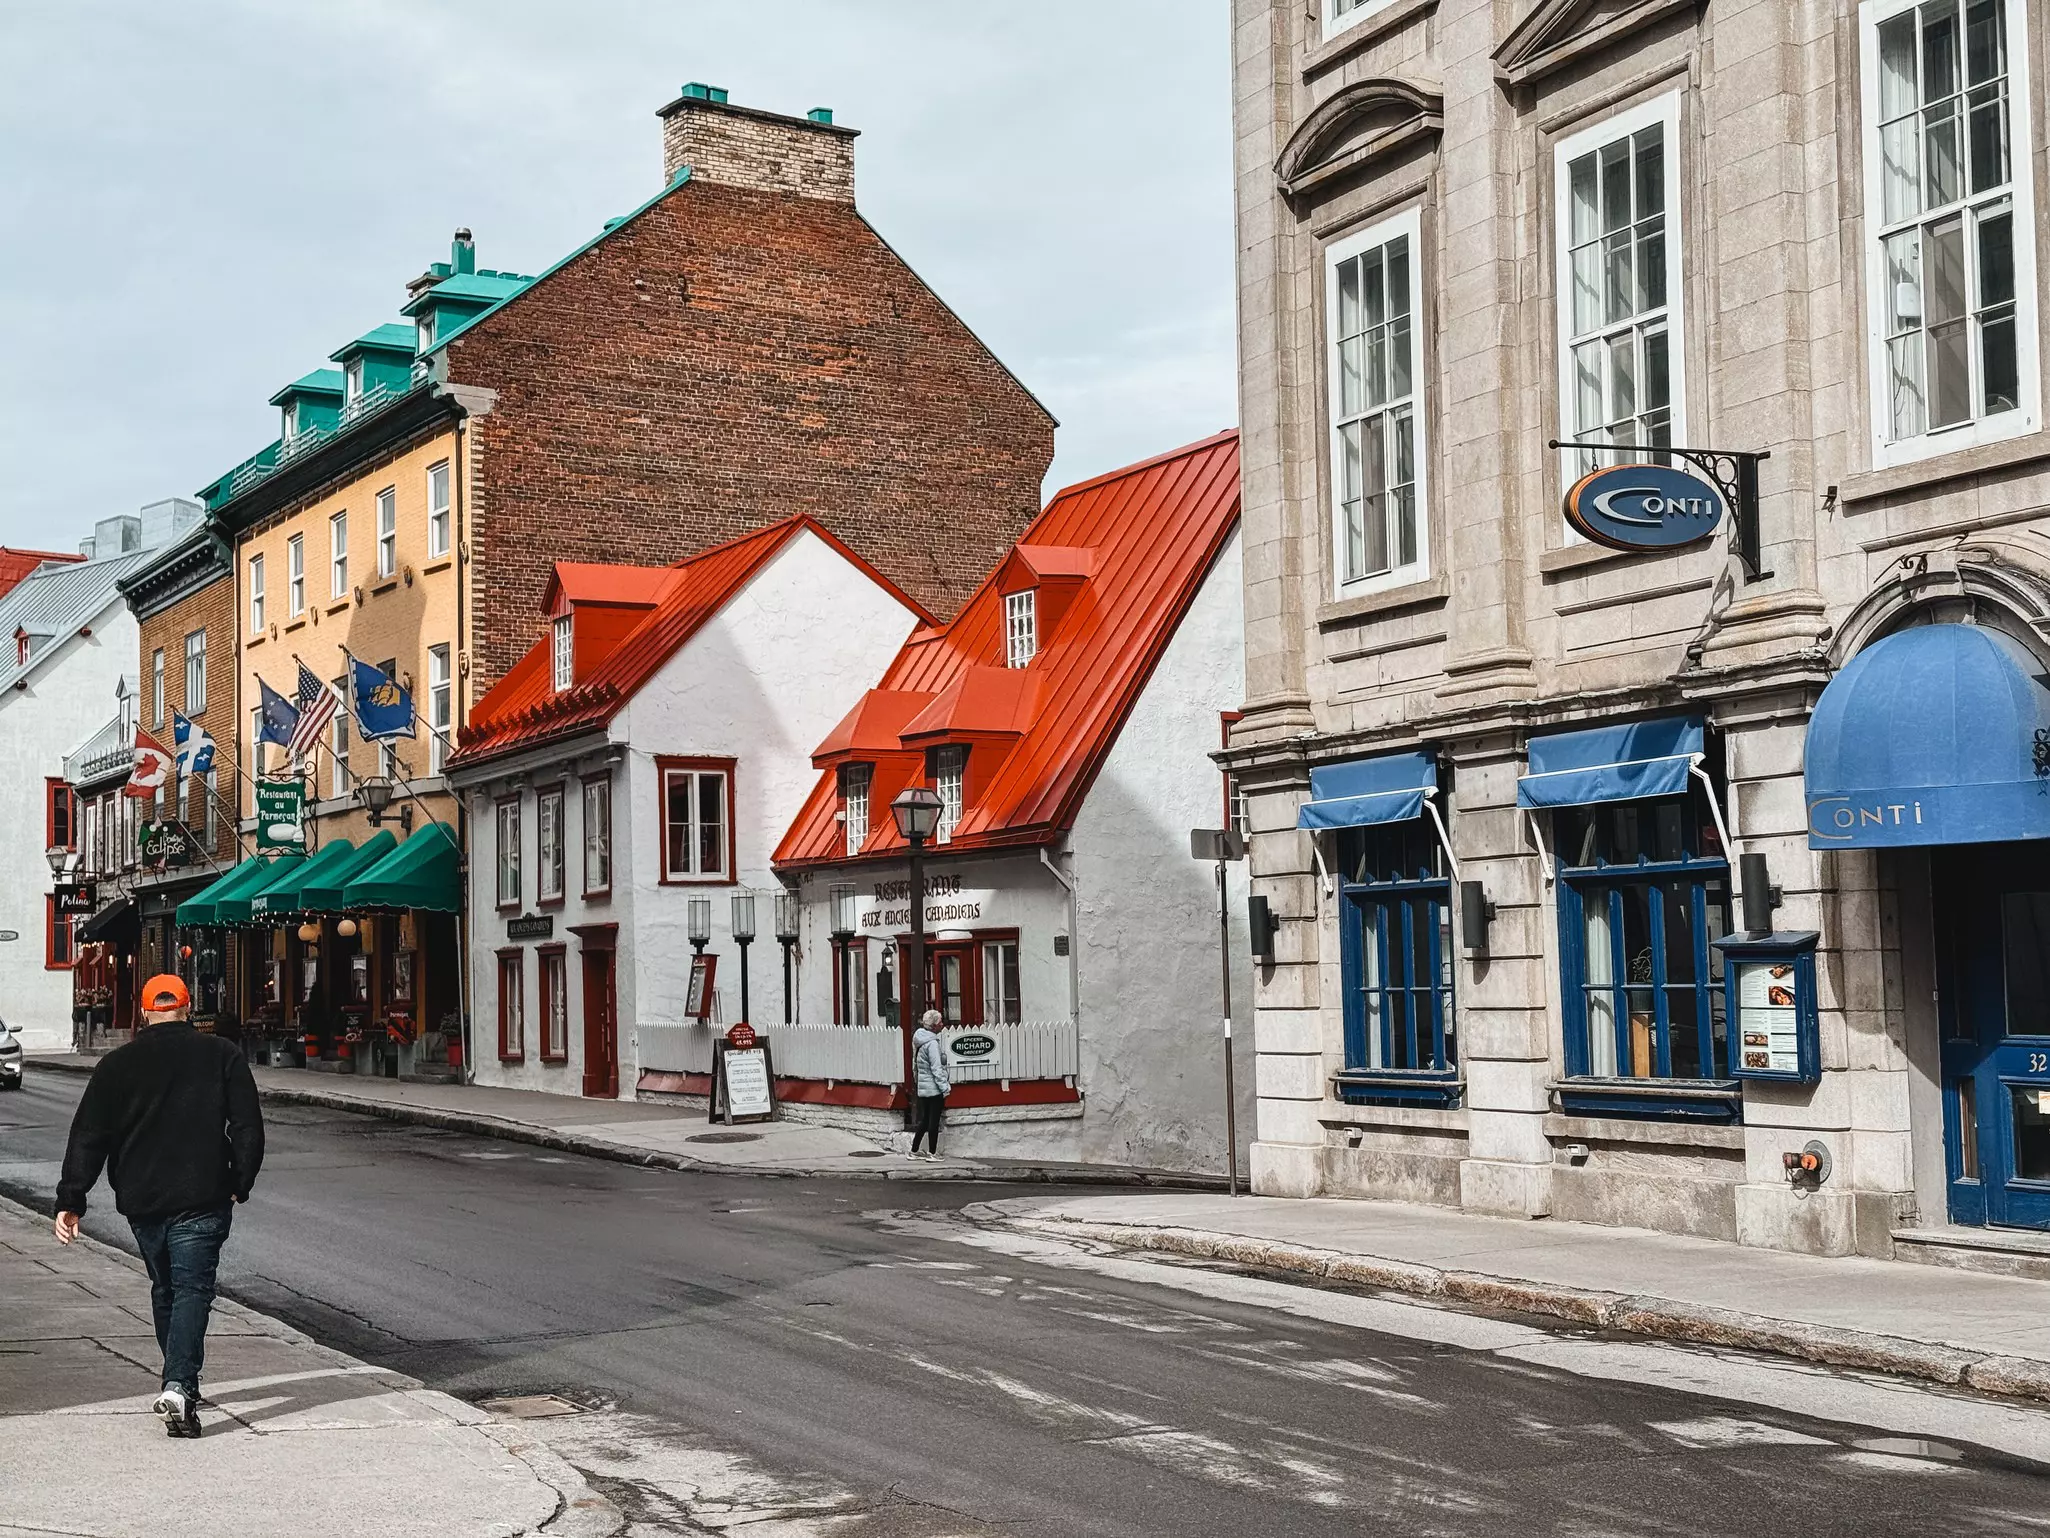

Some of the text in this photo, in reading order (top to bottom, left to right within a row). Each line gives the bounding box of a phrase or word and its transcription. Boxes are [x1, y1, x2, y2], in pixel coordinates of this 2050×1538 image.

[1593, 487, 1712, 524] CONTI
[146, 836, 186, 860] Eclipse
[874, 874, 962, 903] RESTARANT
[861, 909, 881, 928] AUX
[925, 902, 981, 922] CANADIENS
[956, 1042, 991, 1050] RICHARD
[2028, 1054, 2048, 1072] 32
